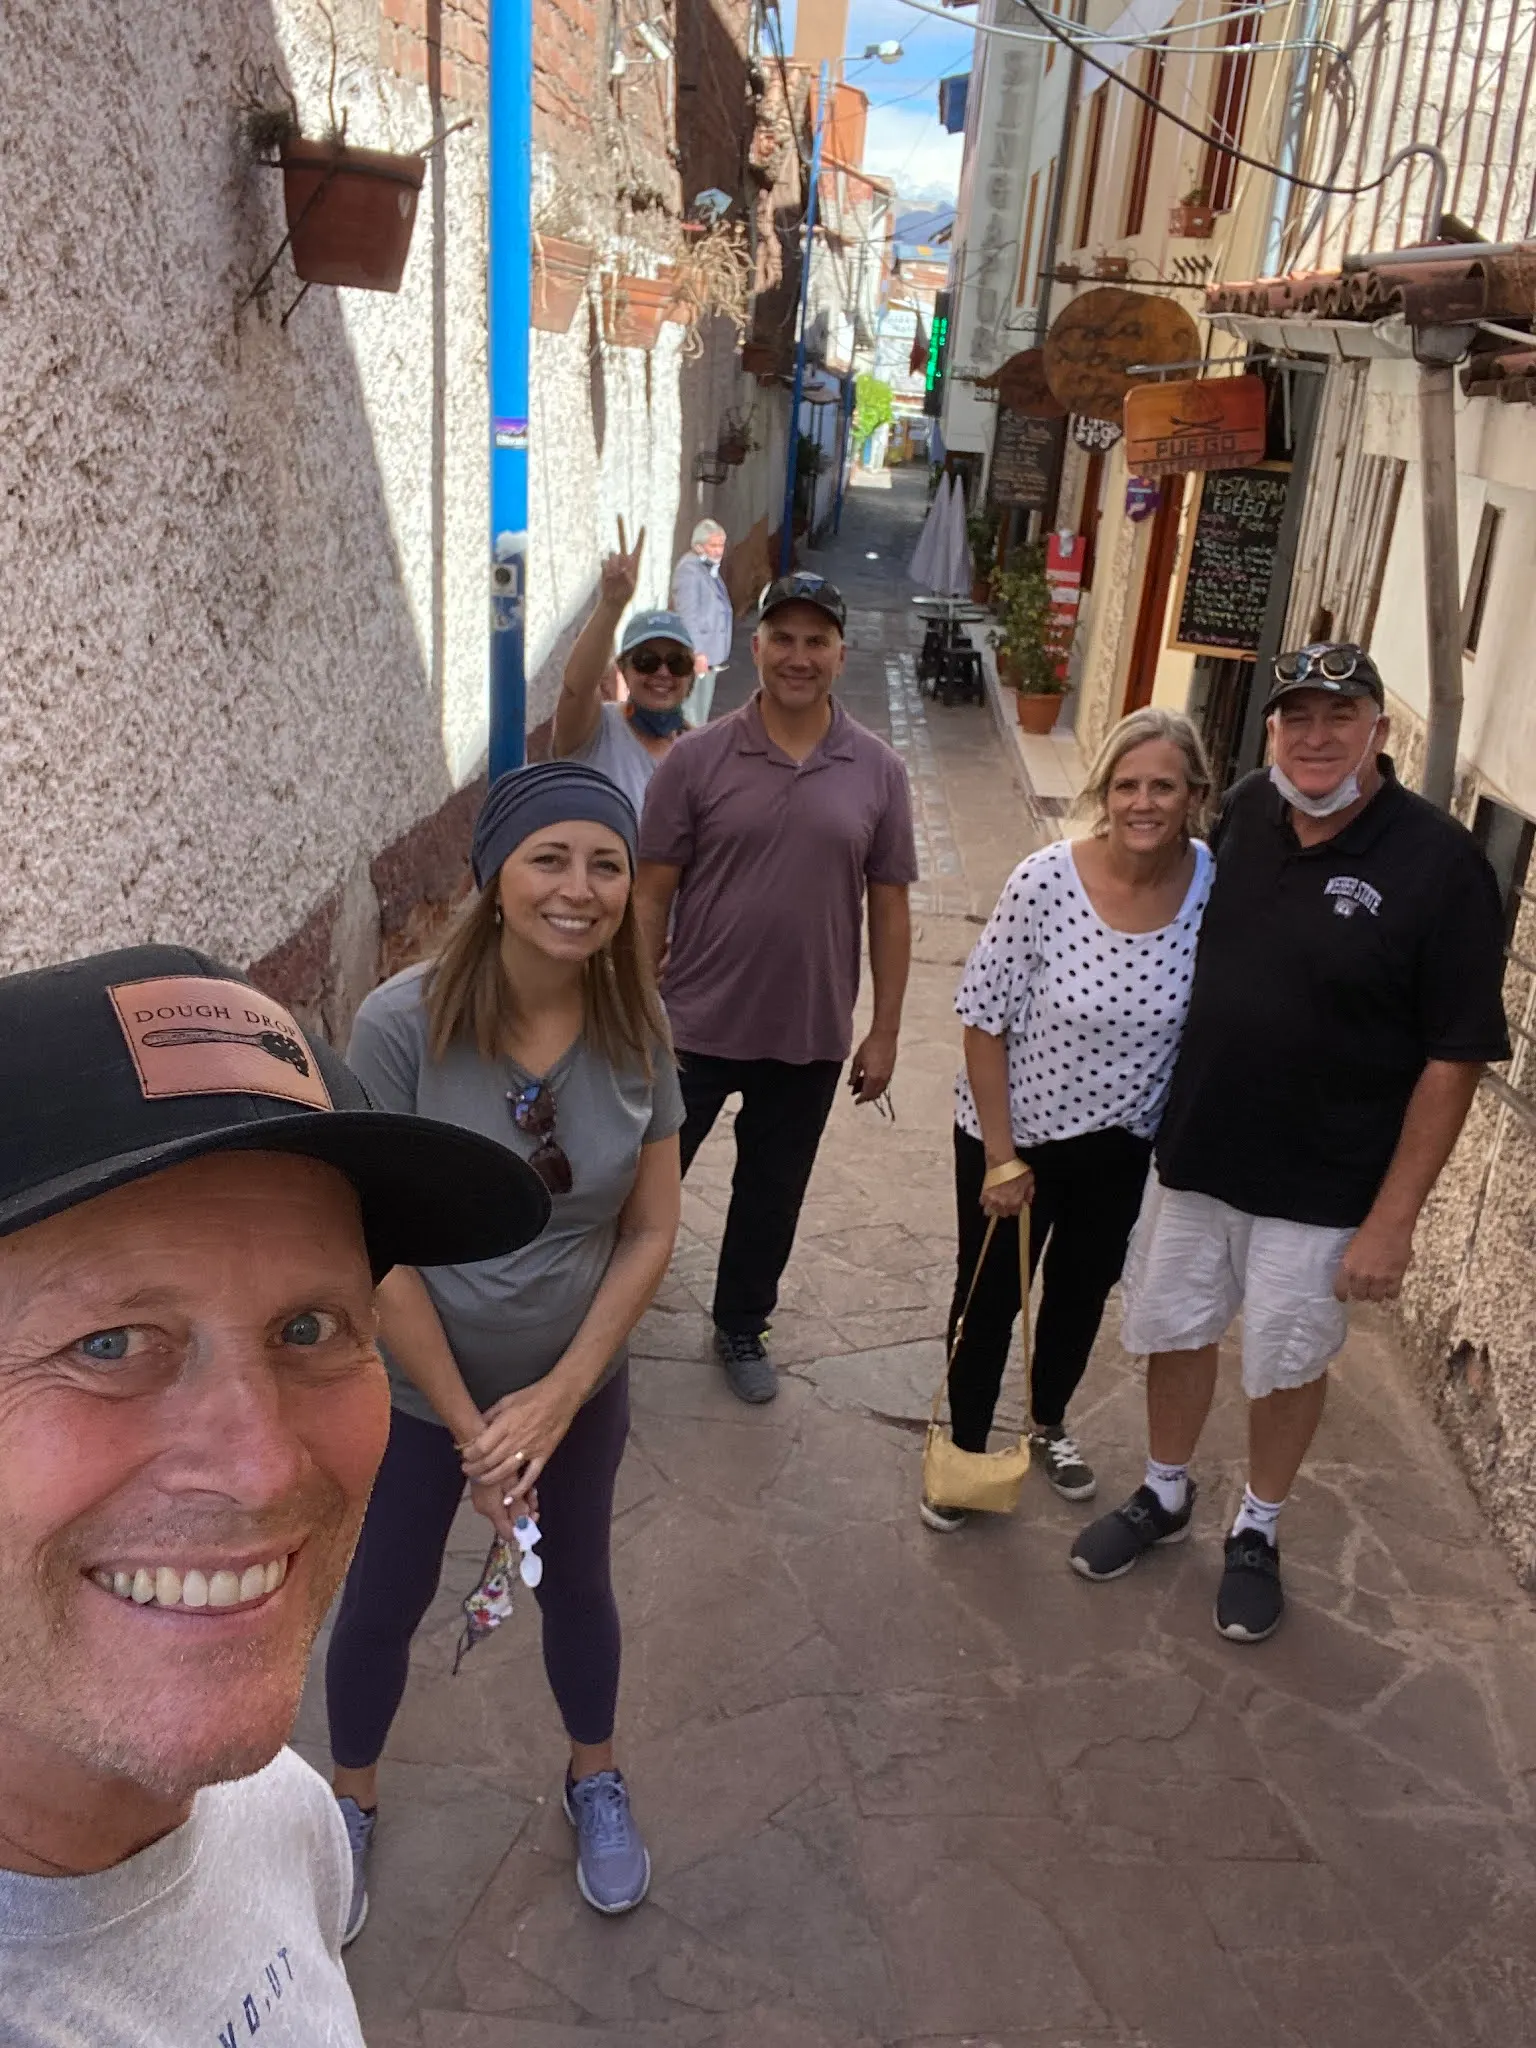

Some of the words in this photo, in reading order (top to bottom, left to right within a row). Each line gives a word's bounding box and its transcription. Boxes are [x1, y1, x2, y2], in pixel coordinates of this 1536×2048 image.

[1155, 434, 1236, 459] FUEGO
[1213, 496, 1268, 519] FUEGO
[133, 1005, 231, 1023] DOUGH
[244, 1010, 296, 1038] DROP
